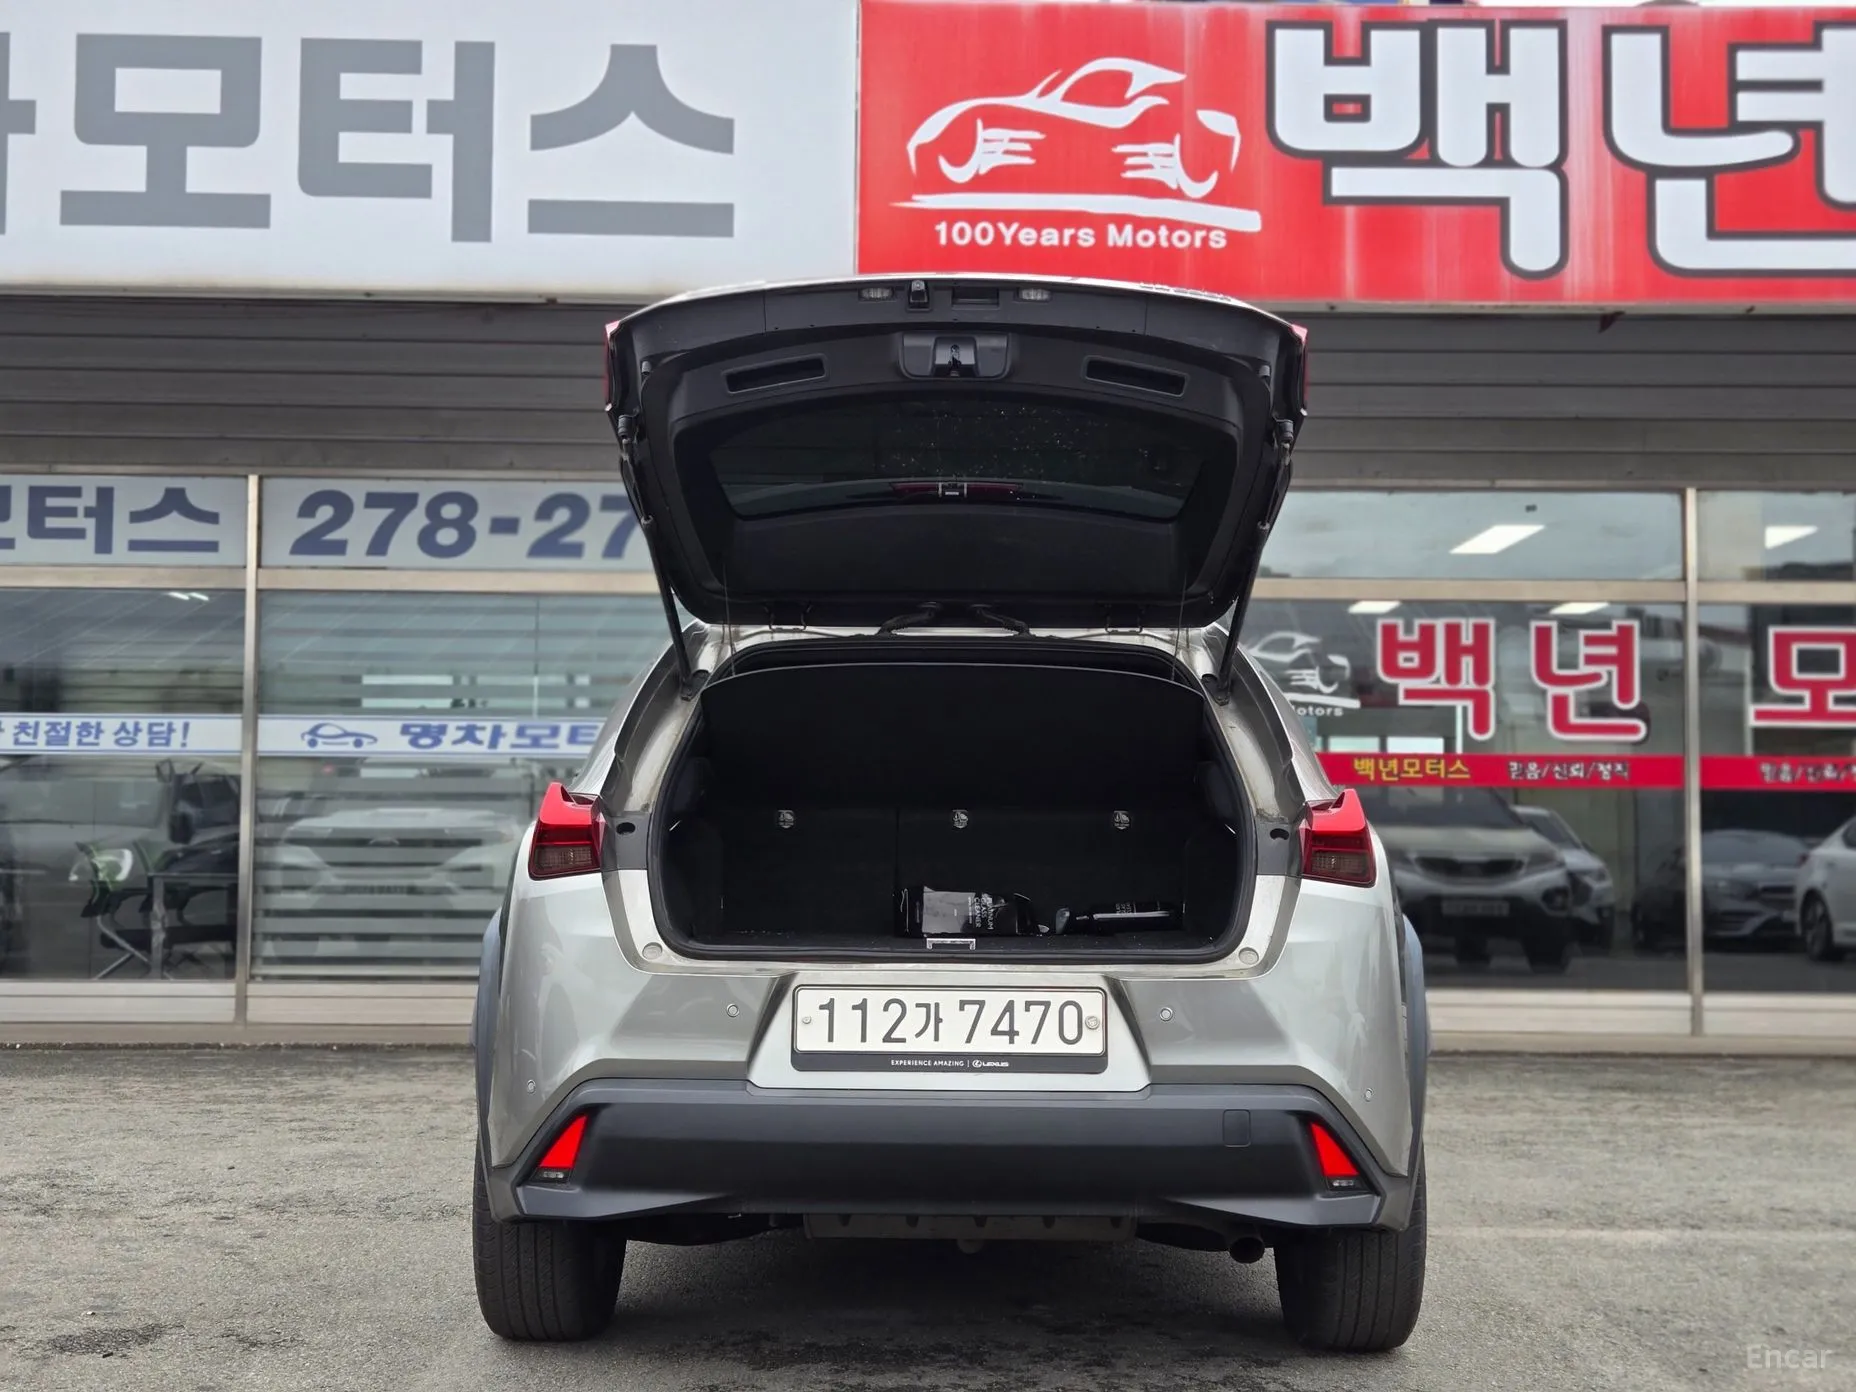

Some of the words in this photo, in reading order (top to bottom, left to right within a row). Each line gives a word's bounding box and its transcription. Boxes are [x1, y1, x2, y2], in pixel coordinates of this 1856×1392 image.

[935, 221, 1096, 248] 100Years
[1107, 223, 1228, 249] Motors
[0, 485, 220, 554] 터스
[1291, 705, 1344, 717] otors
[13, 721, 103, 746] 친절한
[113, 721, 190, 747] 상담!
[1354, 758, 1471, 781] 백년모터스
[818, 997, 943, 1043] 112가
[959, 999, 1084, 1046] 7470
